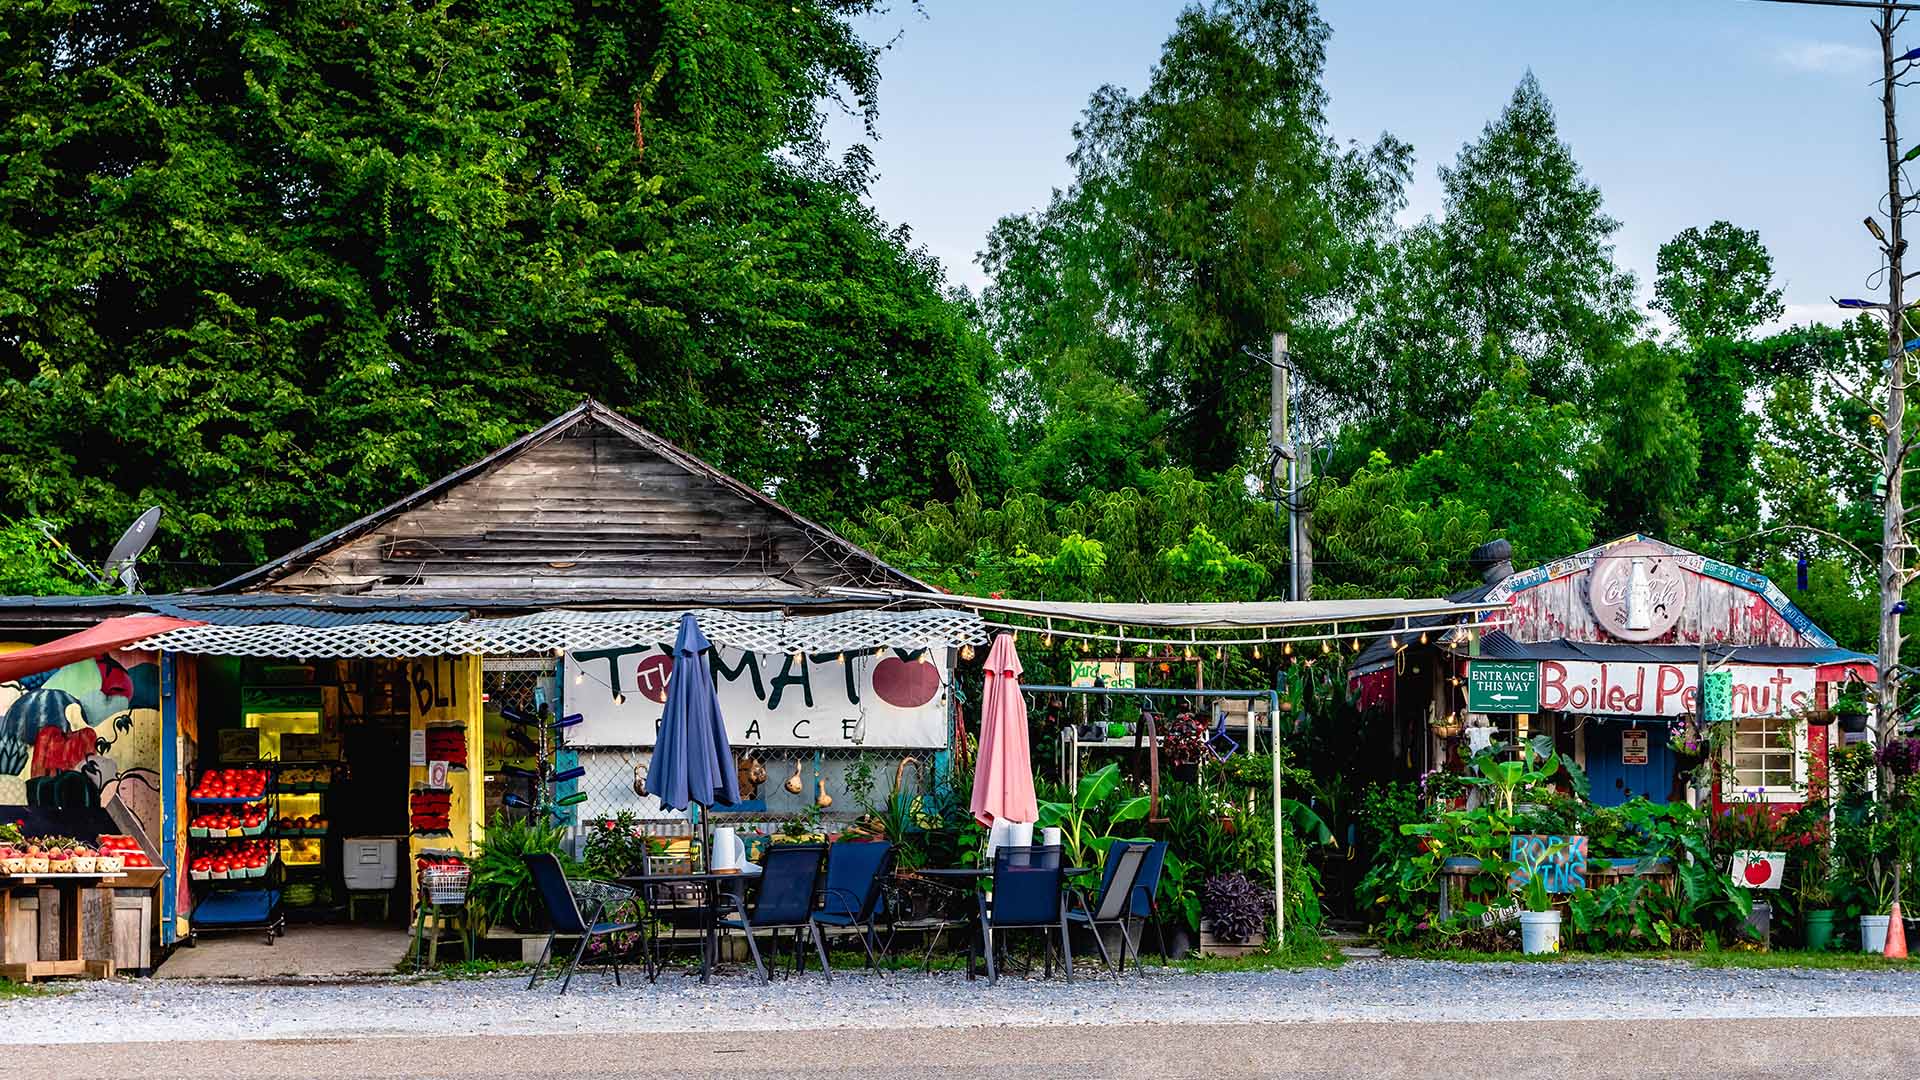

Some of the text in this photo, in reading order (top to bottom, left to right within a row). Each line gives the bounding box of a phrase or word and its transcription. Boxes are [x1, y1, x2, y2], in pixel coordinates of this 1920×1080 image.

[1720, 567, 1734, 578] 914
[1071, 660, 1101, 682] Yard
[1472, 671, 1536, 682] ENTRANCE
[411, 654, 463, 716] BLT
[1477, 681, 1530, 692] THIS WAY
[1540, 660, 1809, 716] Boiled Penuts
[1511, 835, 1585, 863] PORK
